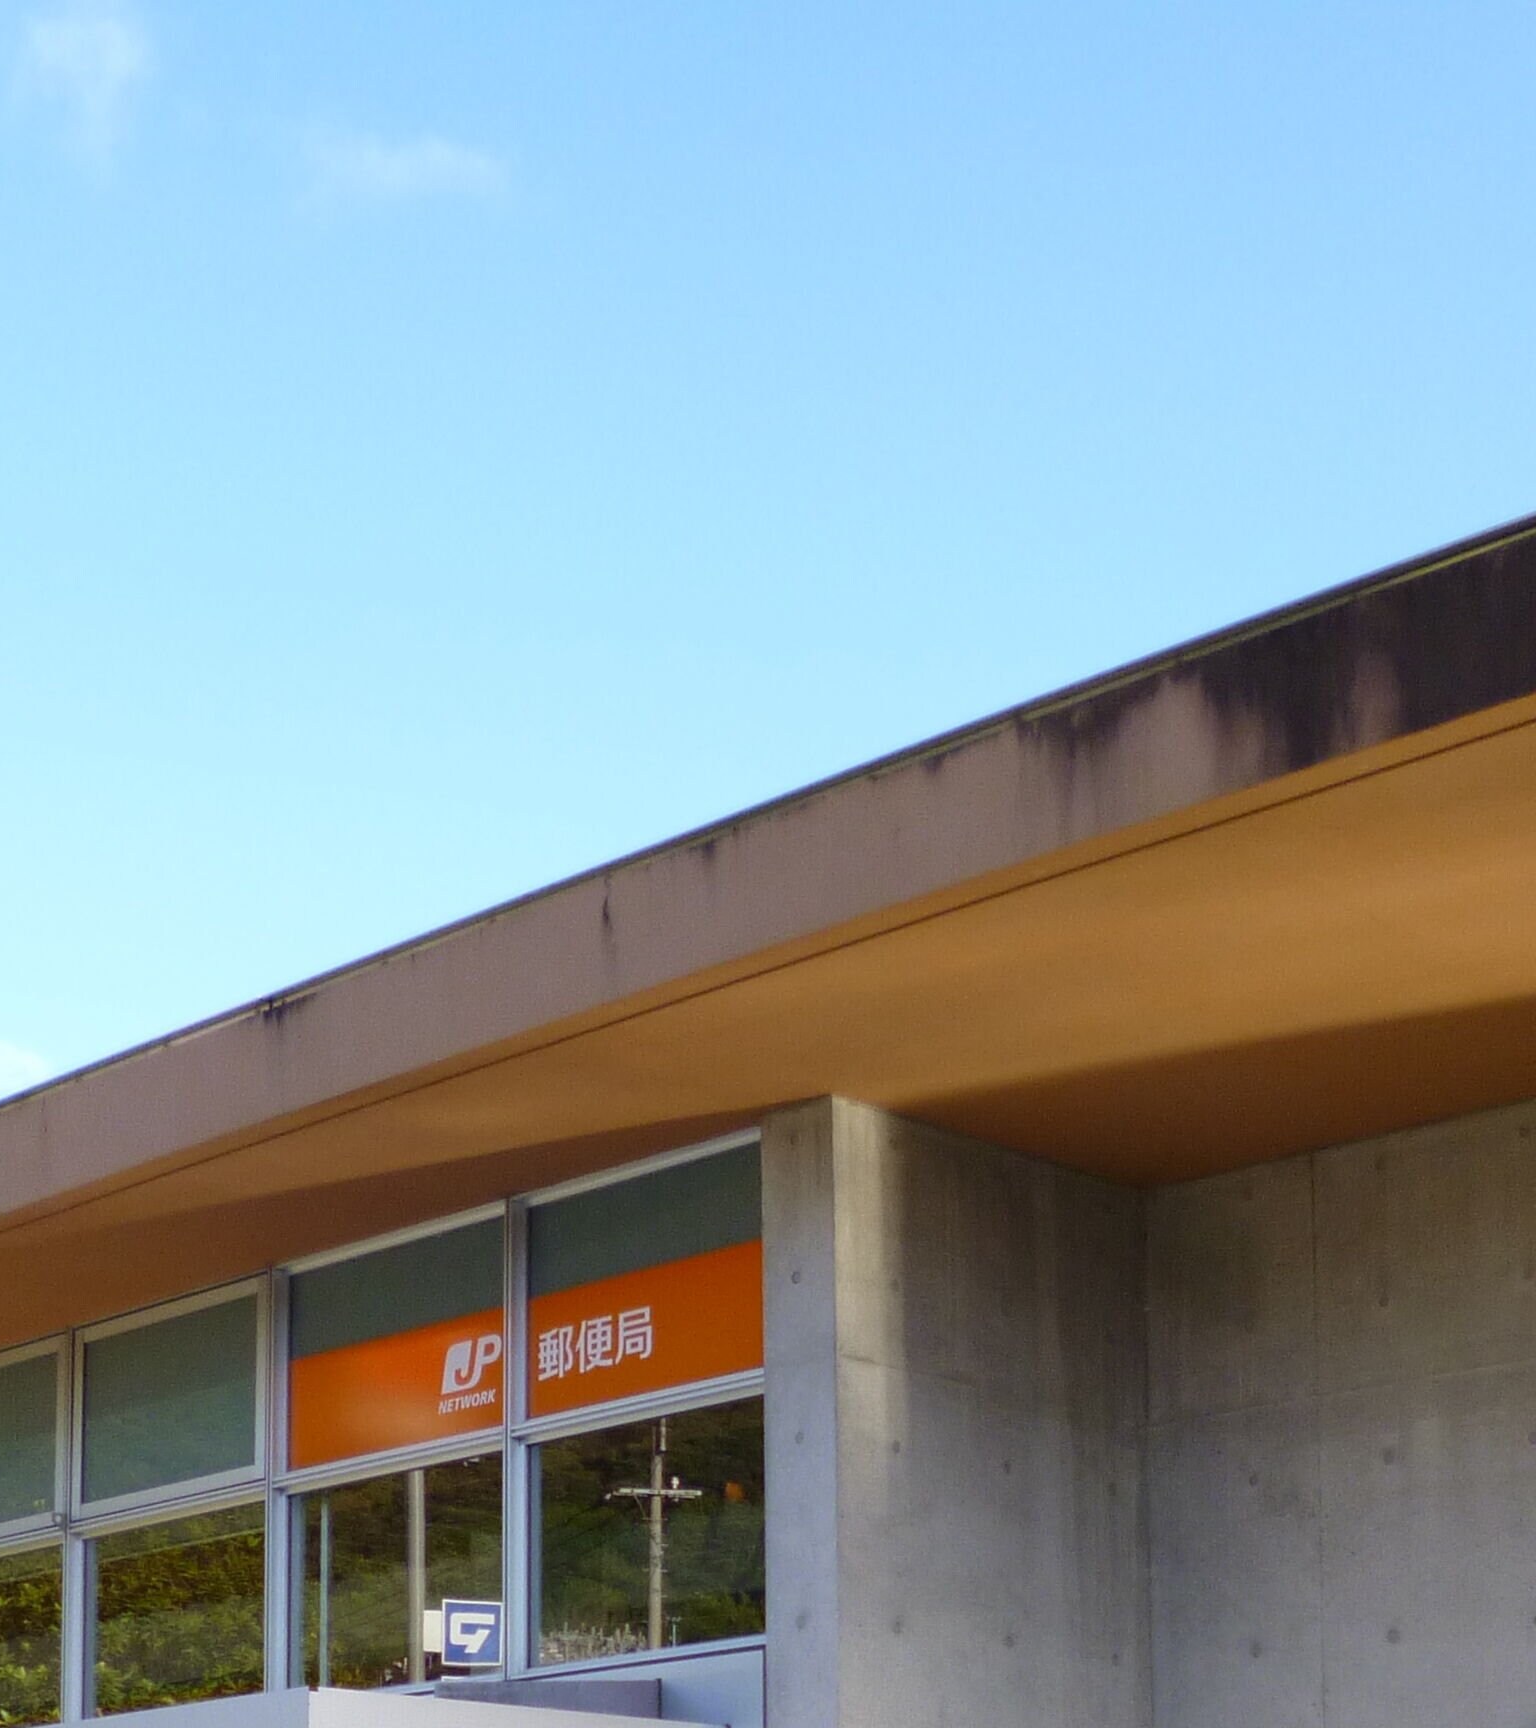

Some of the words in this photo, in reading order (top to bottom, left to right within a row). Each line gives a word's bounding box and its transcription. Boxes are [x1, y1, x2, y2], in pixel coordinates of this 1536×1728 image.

[538, 1306, 652, 1381] 郵便局
[437, 1388, 496, 1415] NETWORK
